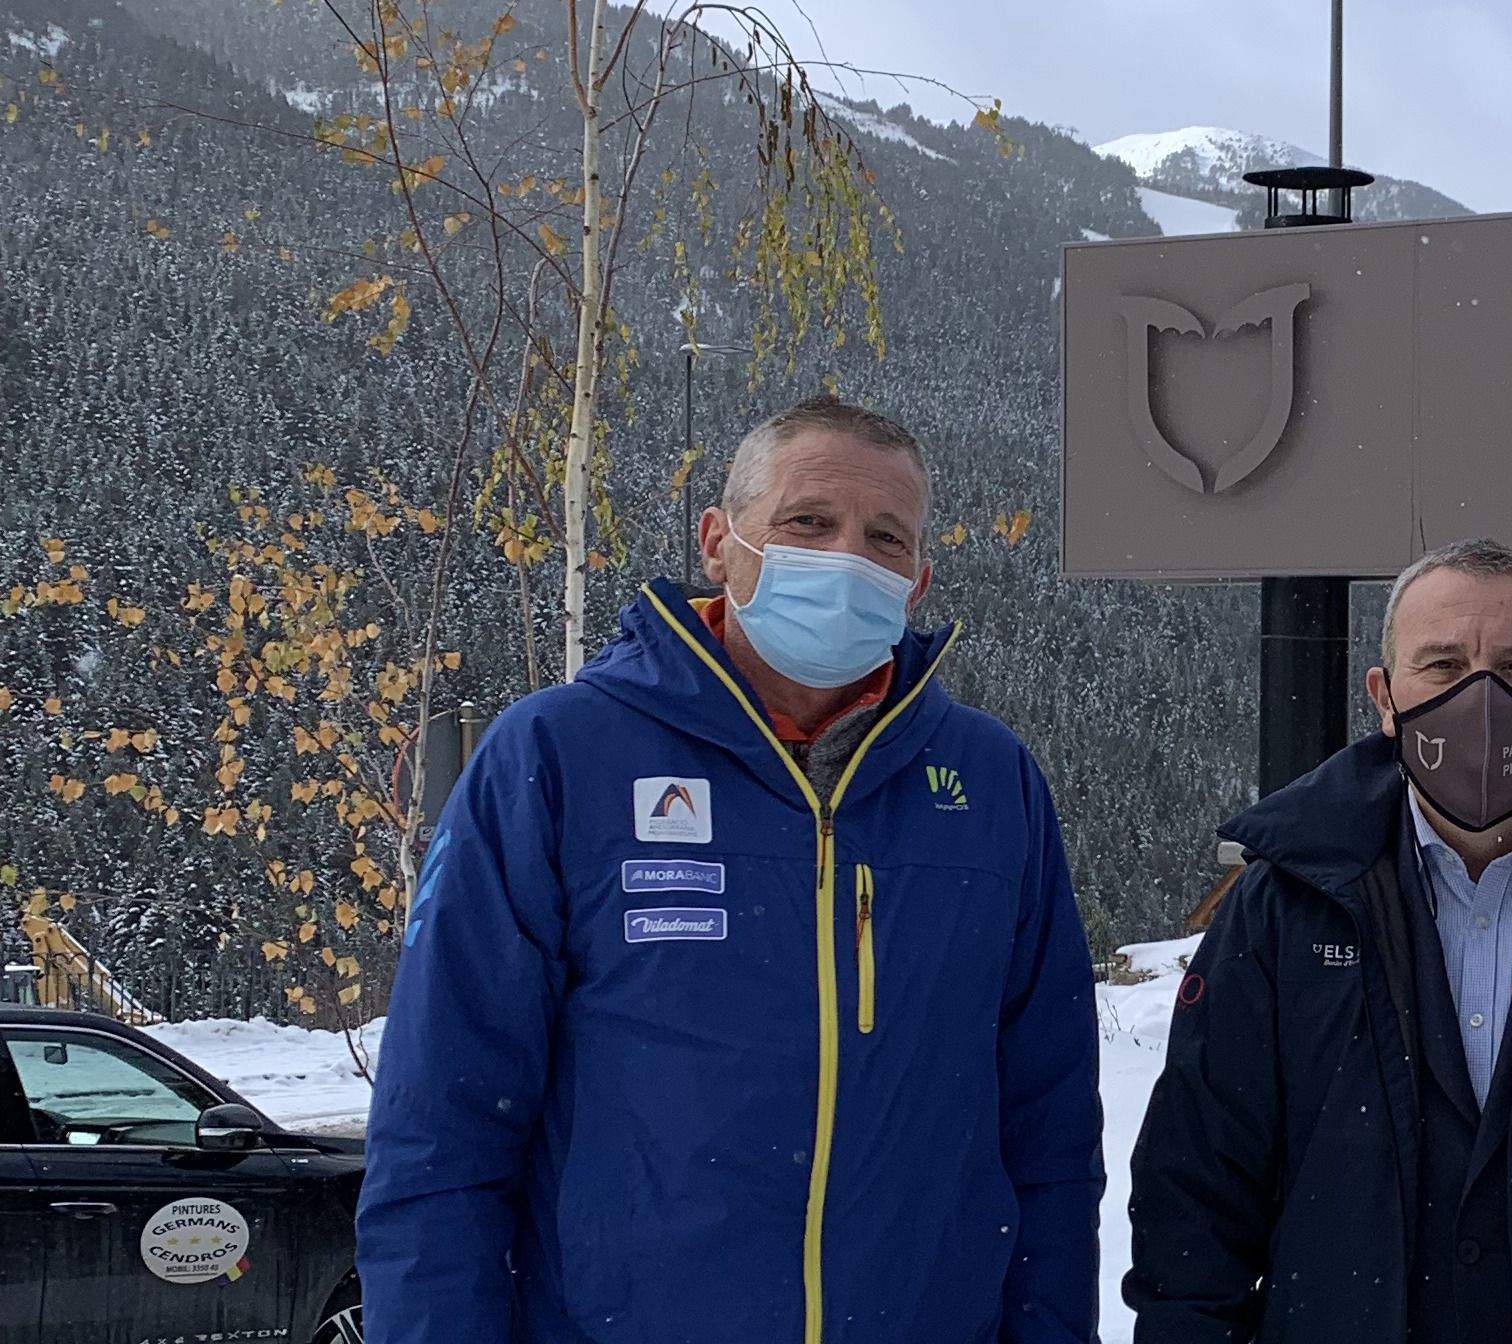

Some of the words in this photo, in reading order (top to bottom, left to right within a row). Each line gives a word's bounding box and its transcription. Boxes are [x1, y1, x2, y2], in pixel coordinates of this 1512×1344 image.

[630, 917, 716, 933] Viladomat
[172, 1204, 221, 1215] PINTURES
[152, 1217, 240, 1236] GERMANS
[149, 1242, 238, 1263] CENDROS
